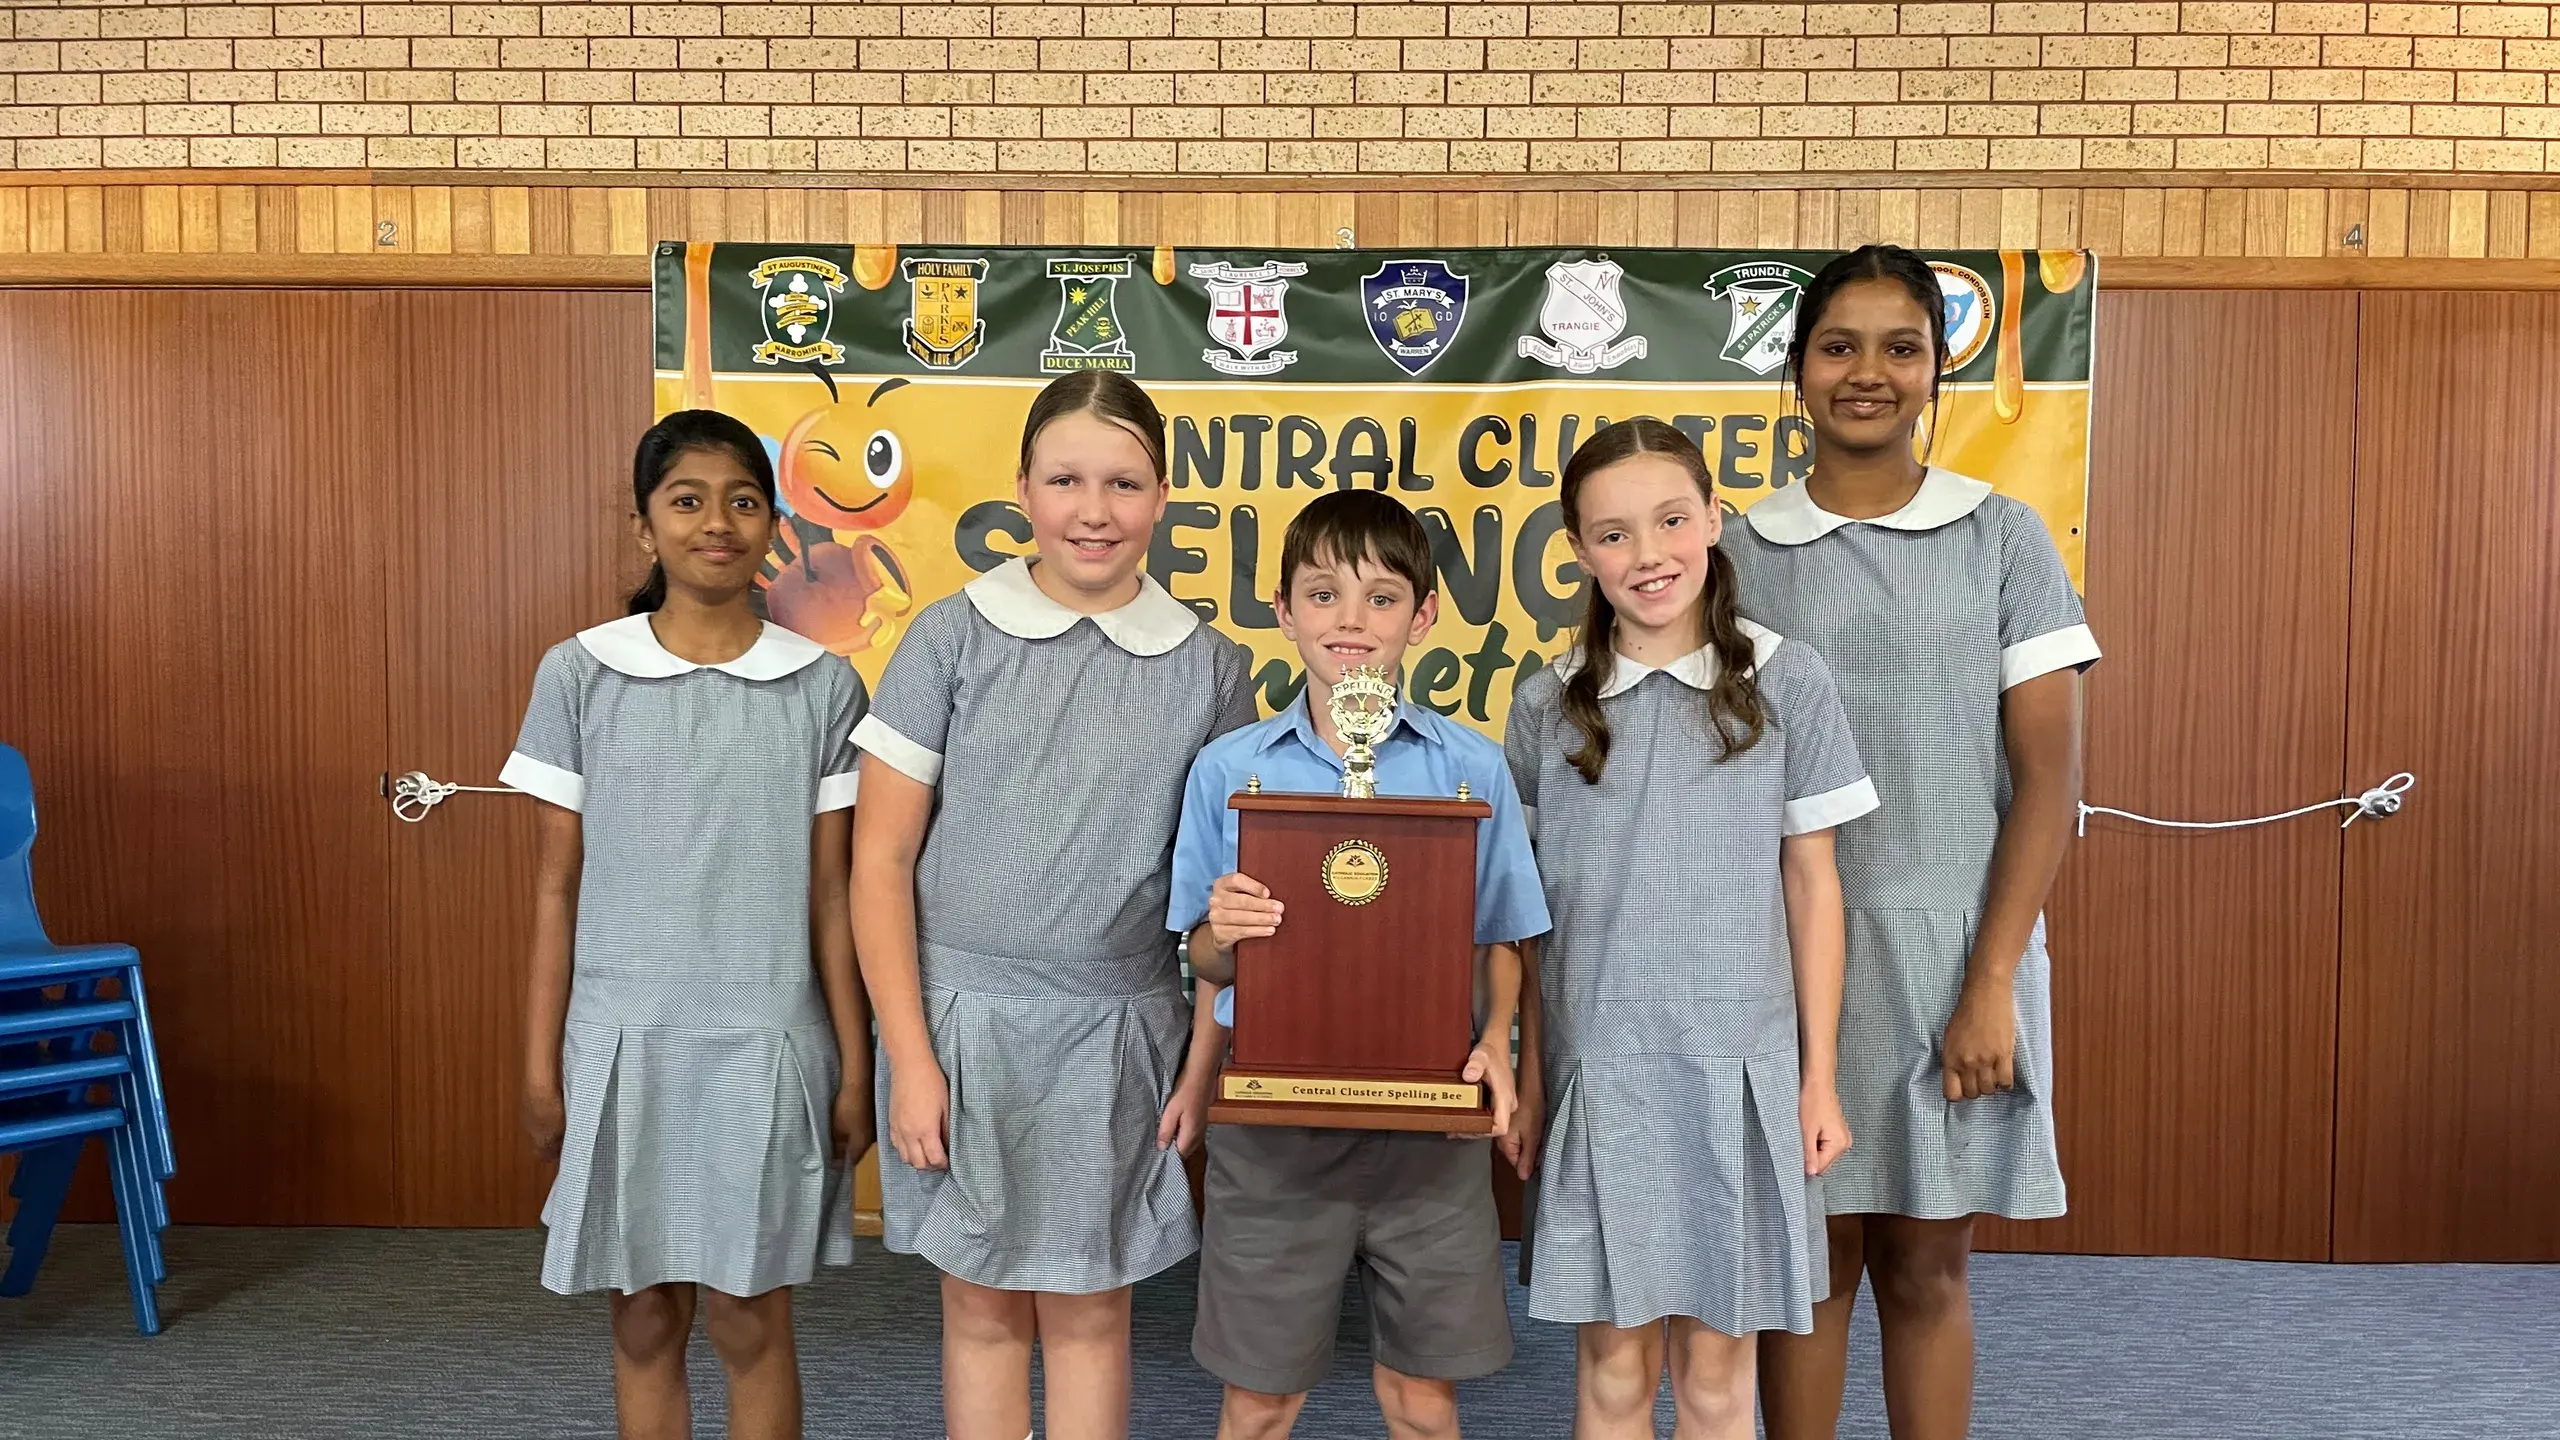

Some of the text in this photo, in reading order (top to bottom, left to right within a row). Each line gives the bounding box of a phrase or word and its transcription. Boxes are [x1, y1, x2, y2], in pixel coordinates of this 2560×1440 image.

[378, 220, 398, 246] 2
[1335, 226, 1355, 249] 3
[2343, 223, 2364, 249] 4
[767, 262, 831, 275] ST AUGUSTINE'S
[917, 262, 973, 276] HOLY FAMILY
[1054, 263, 1124, 273] ST. JOSEPHS
[1733, 266, 1791, 279] TRUNDLE
[1386, 289, 1442, 300] ST. MARY'S
[1559, 273, 1616, 322] ST. JOHN'S
[1931, 266, 1990, 319] HOOL CONDOBOLIN
[938, 282, 950, 345] PARKES
[1065, 297, 1108, 338] PEAK HILL
[1746, 302, 1786, 341] PATRICK'S
[1552, 322, 1600, 331] TRANGIE
[774, 344, 822, 357] NARROMINE
[1046, 357, 1130, 369] DUCE MARIA
[1159, 414, 1434, 491] NTRAL
[1292, 1085, 1463, 1101] Central Cluster Spelling Bee
